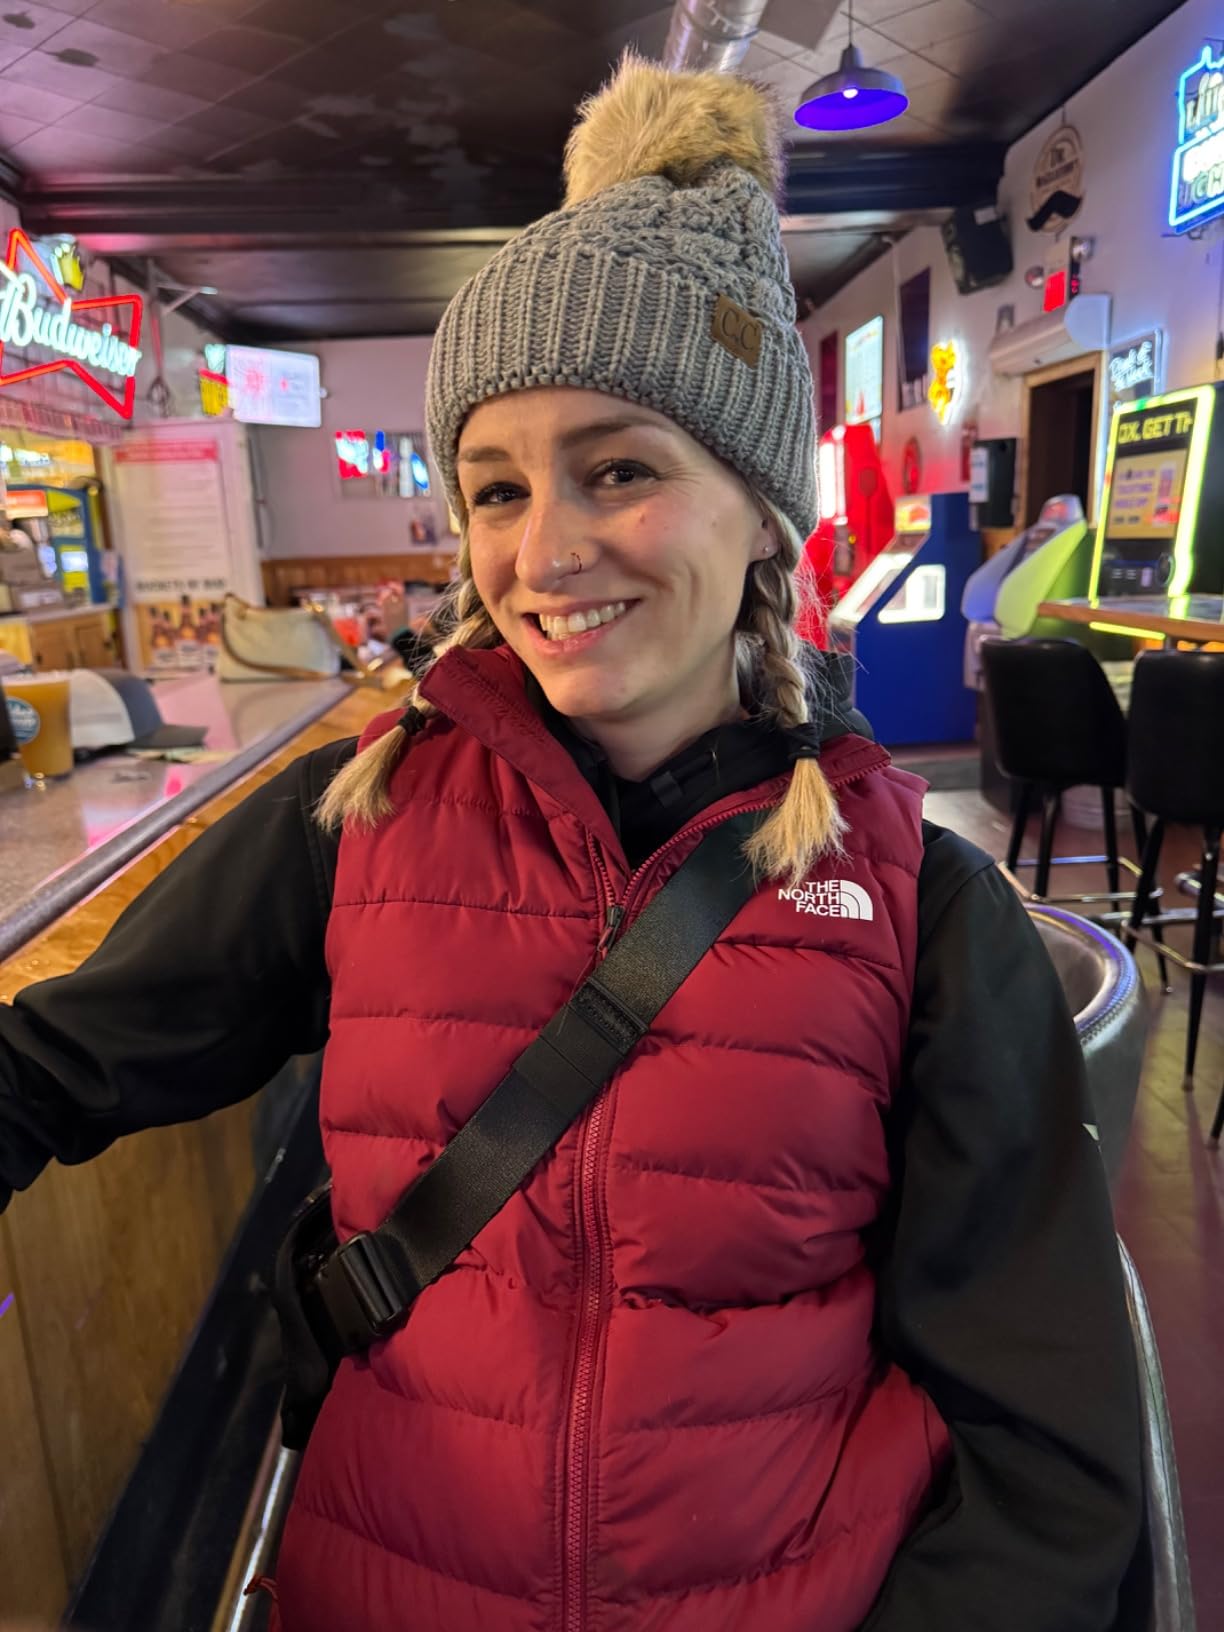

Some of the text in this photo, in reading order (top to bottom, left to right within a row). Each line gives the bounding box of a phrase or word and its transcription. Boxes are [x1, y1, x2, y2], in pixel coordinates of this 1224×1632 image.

[1142, 414, 1174, 440] GET
[806, 880, 840, 893] THE
[778, 889, 840, 905] NORTH
[796, 901, 840, 917] FACE
